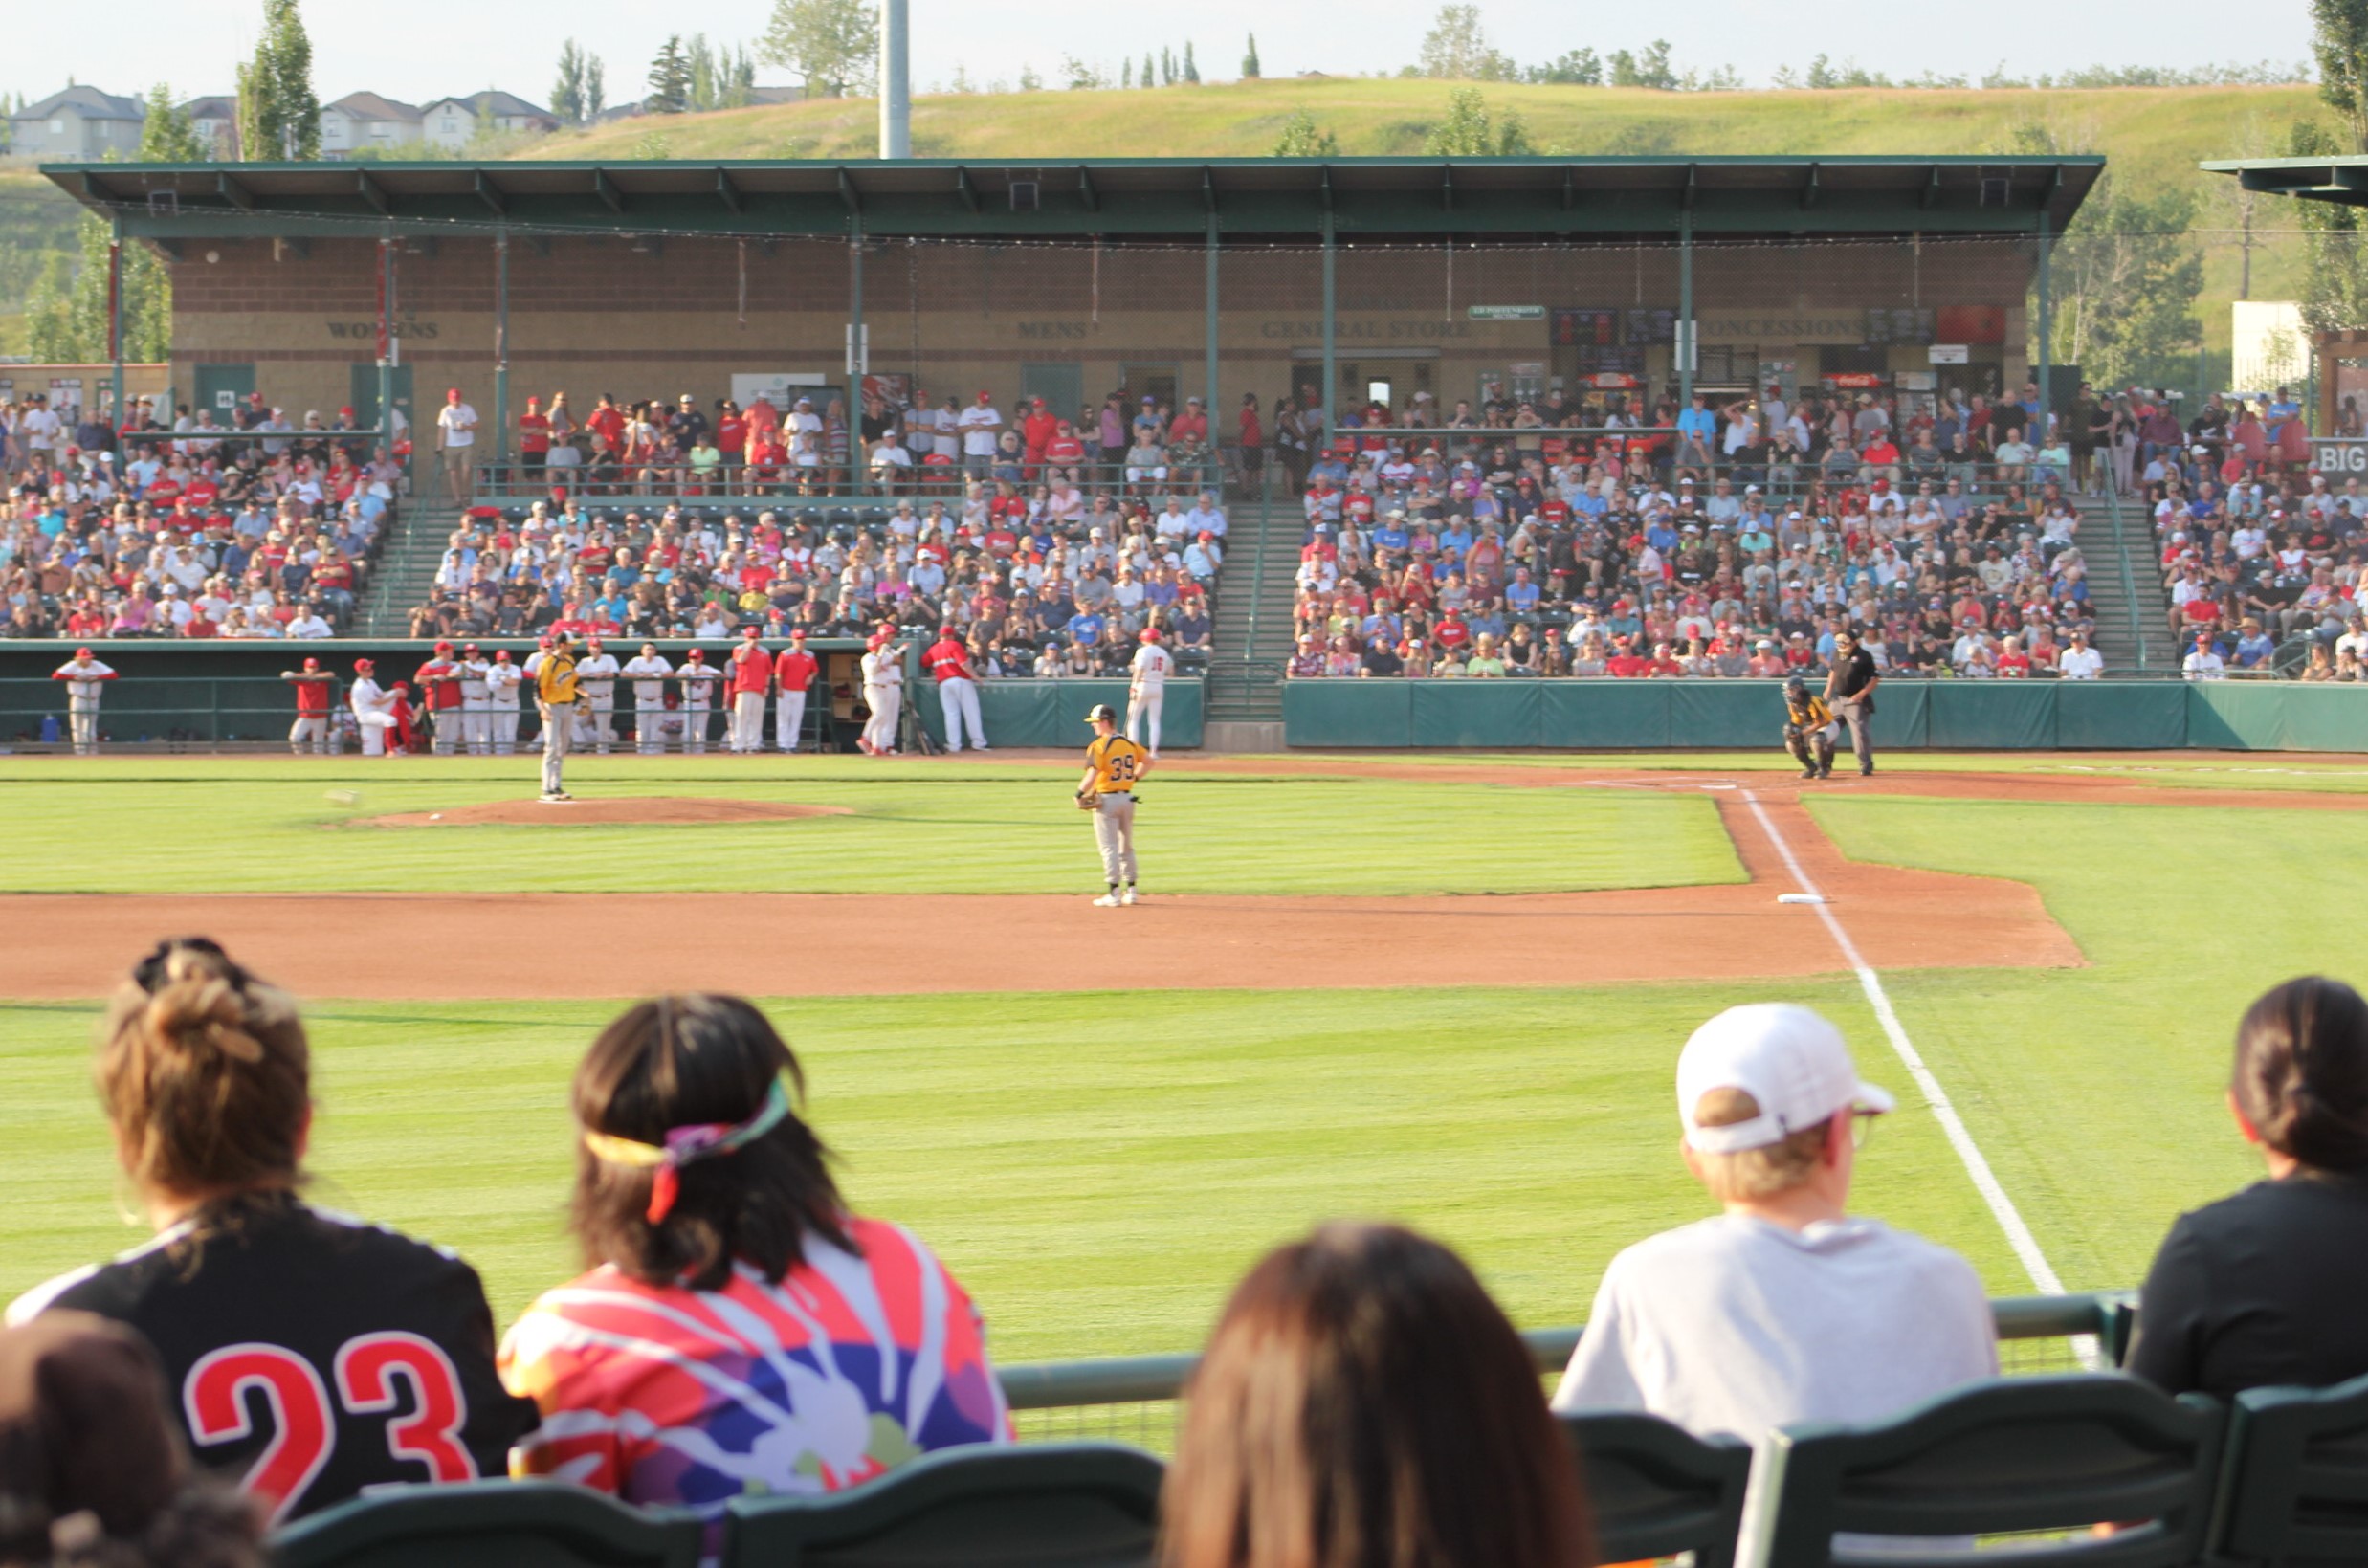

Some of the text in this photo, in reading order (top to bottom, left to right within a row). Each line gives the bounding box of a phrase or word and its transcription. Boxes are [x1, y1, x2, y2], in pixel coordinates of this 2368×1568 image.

[1018, 321, 1087, 338] MENS
[1389, 321, 1471, 338] STORE
[2319, 447, 2366, 472] BIG
[1110, 753, 1135, 782] 39
[182, 1330, 478, 1530] 23
